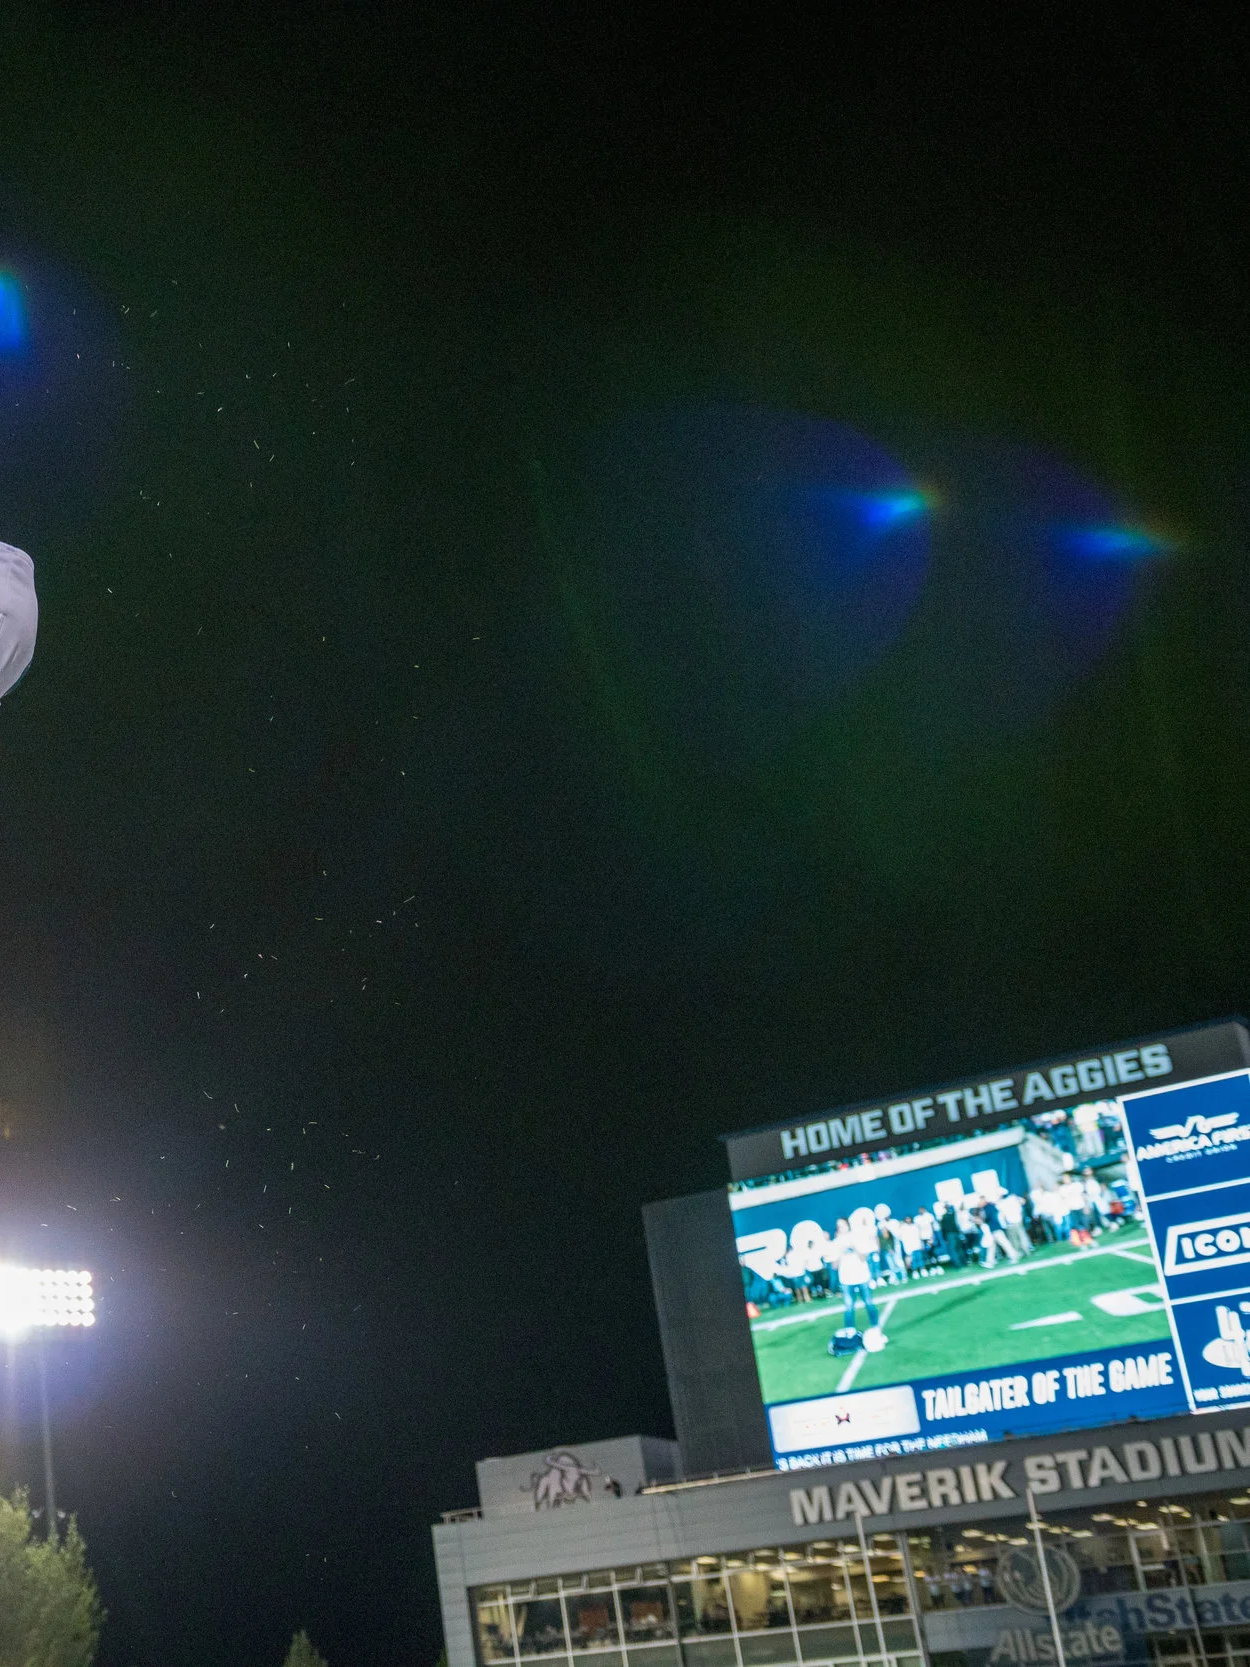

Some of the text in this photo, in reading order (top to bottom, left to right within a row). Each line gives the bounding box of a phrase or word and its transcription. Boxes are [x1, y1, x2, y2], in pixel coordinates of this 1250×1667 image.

[780, 1043, 1173, 1160] HOME OF THE AGGIES
[921, 1375, 1030, 1421] TAILGATER
[1032, 1370, 1060, 1405] OF
[1062, 1363, 1107, 1399] THE
[1108, 1352, 1174, 1393] GAME
[790, 1427, 1250, 1527] MAVERIK STADIUM
[990, 1621, 1123, 1663] Allsate
